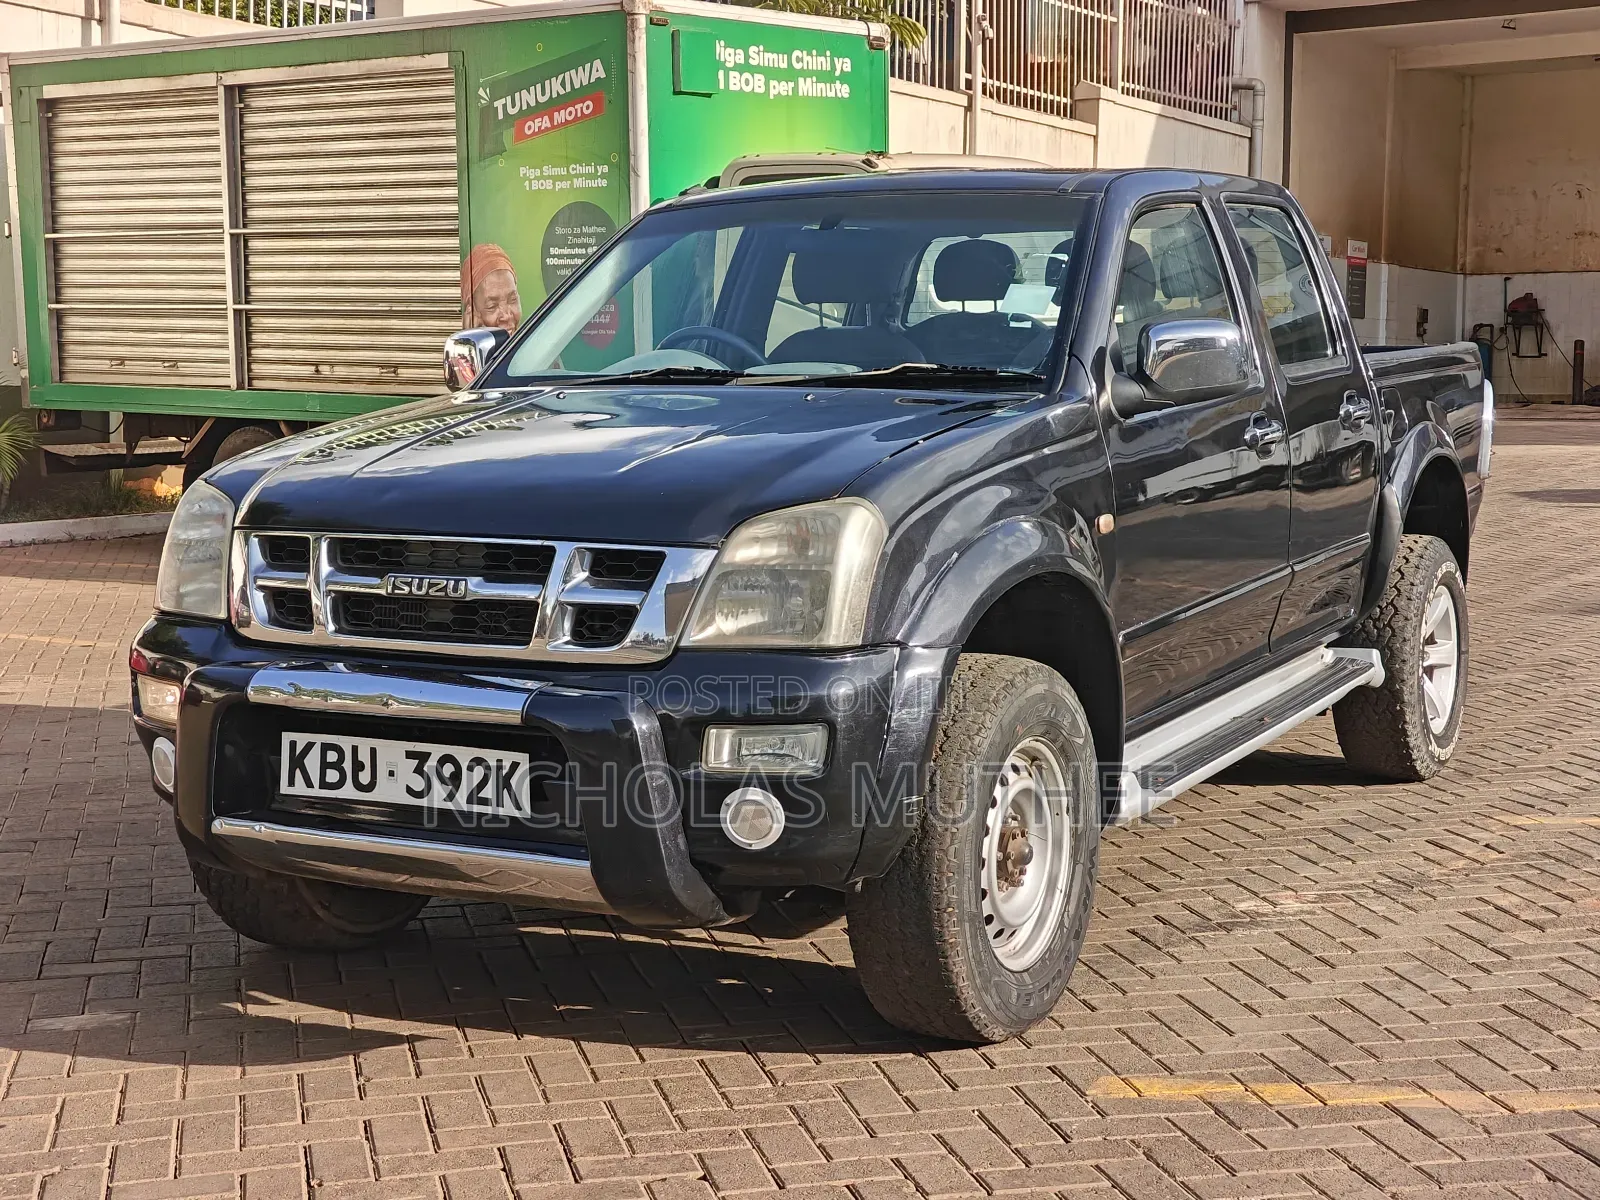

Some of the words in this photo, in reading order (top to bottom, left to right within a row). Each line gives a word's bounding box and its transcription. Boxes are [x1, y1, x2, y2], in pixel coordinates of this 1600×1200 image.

[748, 44, 788, 69] Simu
[791, 49, 831, 71] Chini
[834, 56, 852, 76] ya
[493, 58, 607, 120] TUNUKIWA
[718, 69, 725, 90] 1
[728, 70, 766, 94] BOB
[769, 79, 795, 99] per
[797, 76, 850, 98] Minute
[524, 116, 552, 135] OFA
[553, 100, 594, 126] MOTO
[519, 165, 541, 179] Piga
[542, 164, 568, 176] Simu
[569, 162, 595, 175] Chini
[596, 164, 609, 176] ya
[523, 180, 530, 191] 1
[531, 179, 554, 191] BOB
[555, 180, 572, 191] per
[573, 177, 608, 189] Minute
[582, 225, 607, 233] Mathee
[549, 245, 586, 255] 50minutes
[387, 576, 466, 598] ISUZU
[287, 739, 378, 793] KBU
[404, 750, 524, 811] 392K
